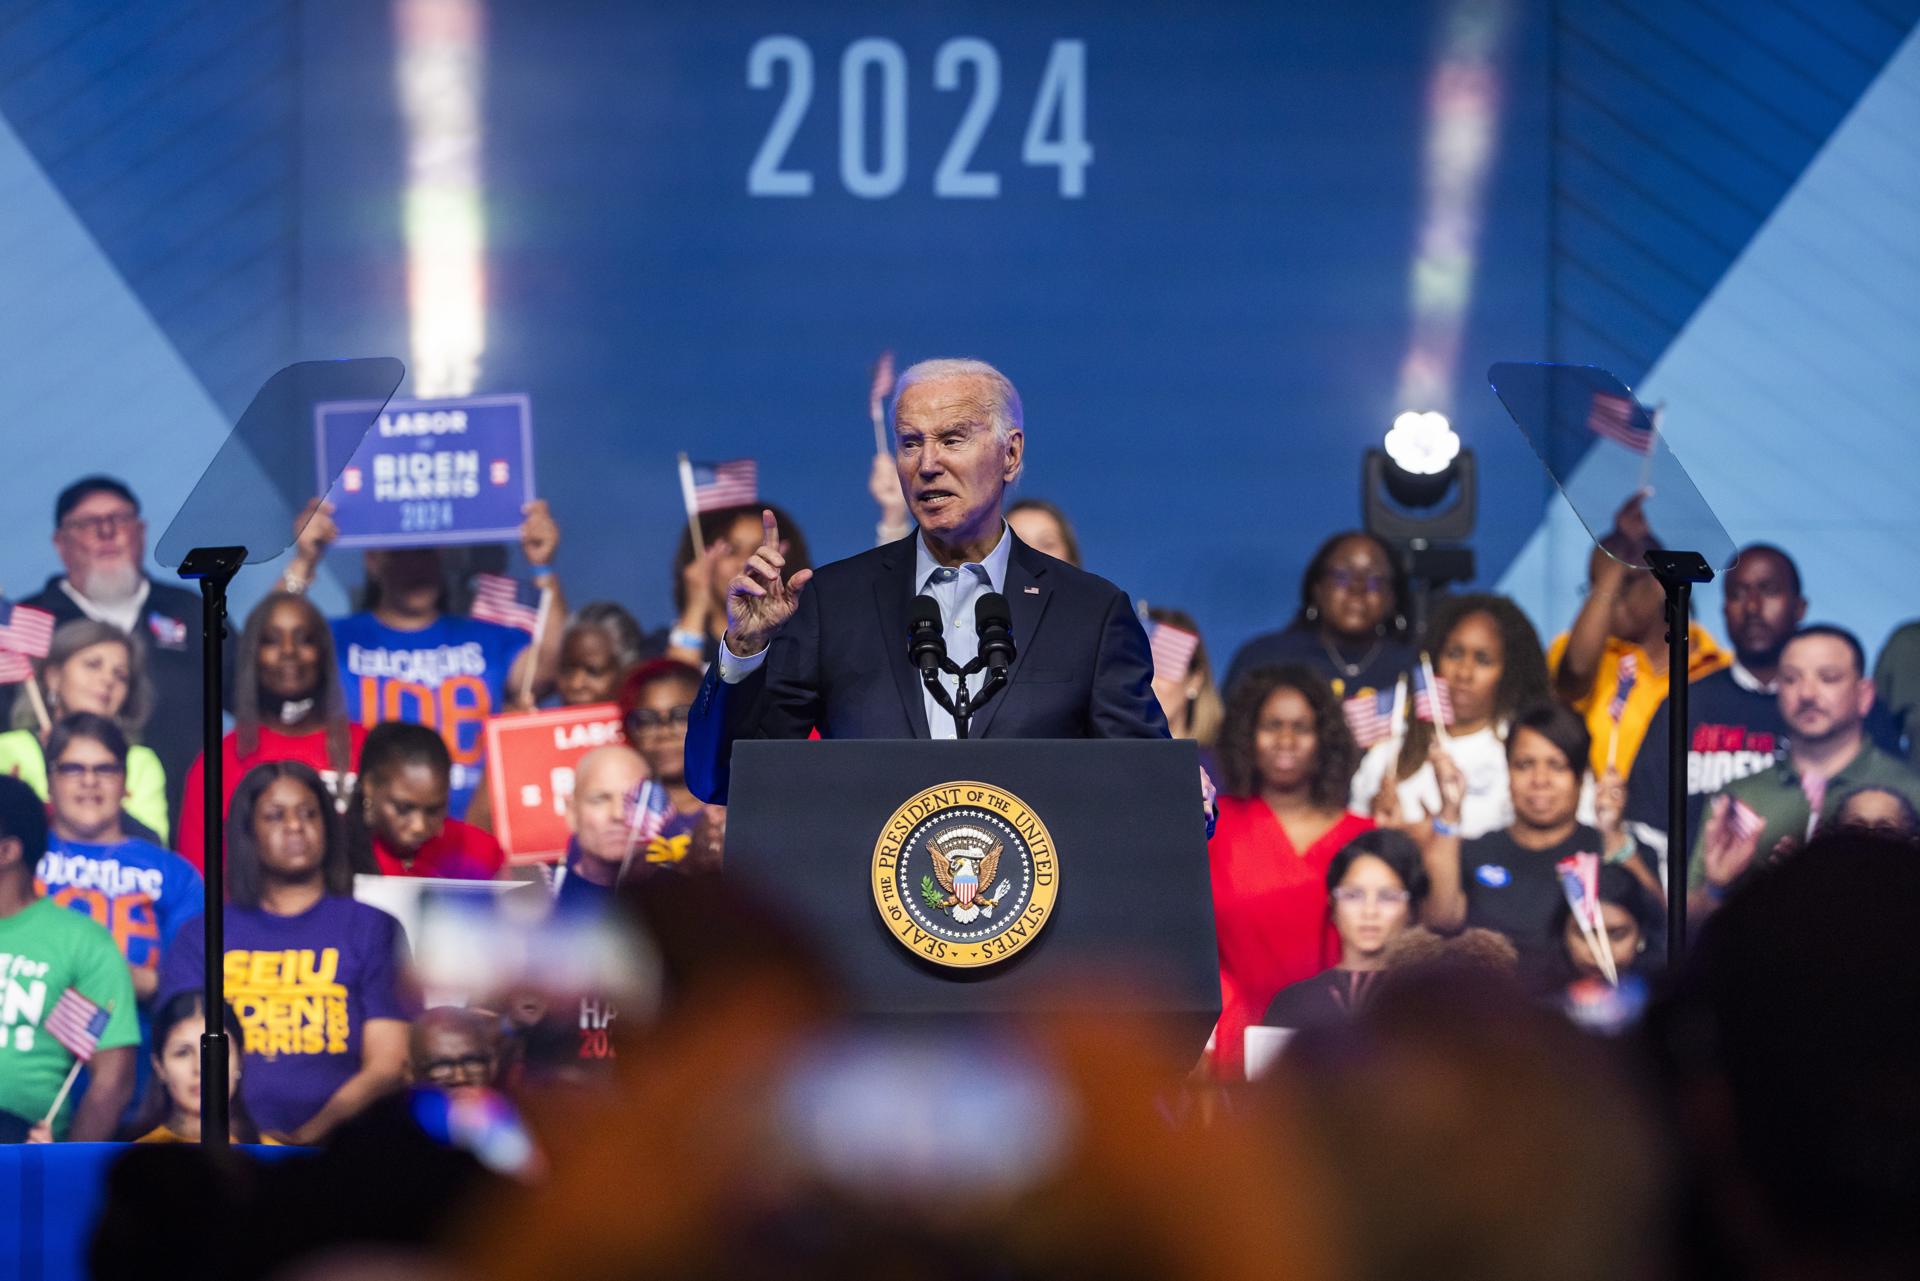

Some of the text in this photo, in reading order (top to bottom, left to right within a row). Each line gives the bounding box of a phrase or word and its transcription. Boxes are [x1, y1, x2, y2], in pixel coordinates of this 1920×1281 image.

[746, 34, 1094, 198] 2024
[379, 410, 468, 437] LABOR
[373, 450, 479, 482] BIDEN
[374, 477, 480, 501] HARRIS
[879, 788, 1053, 959] SEAL OF THE PRESIDENT OF THE UNITED STATES
[223, 948, 339, 985] SEIU
[230, 996, 325, 1026] DEN
[243, 1024, 326, 1055] RRIS
